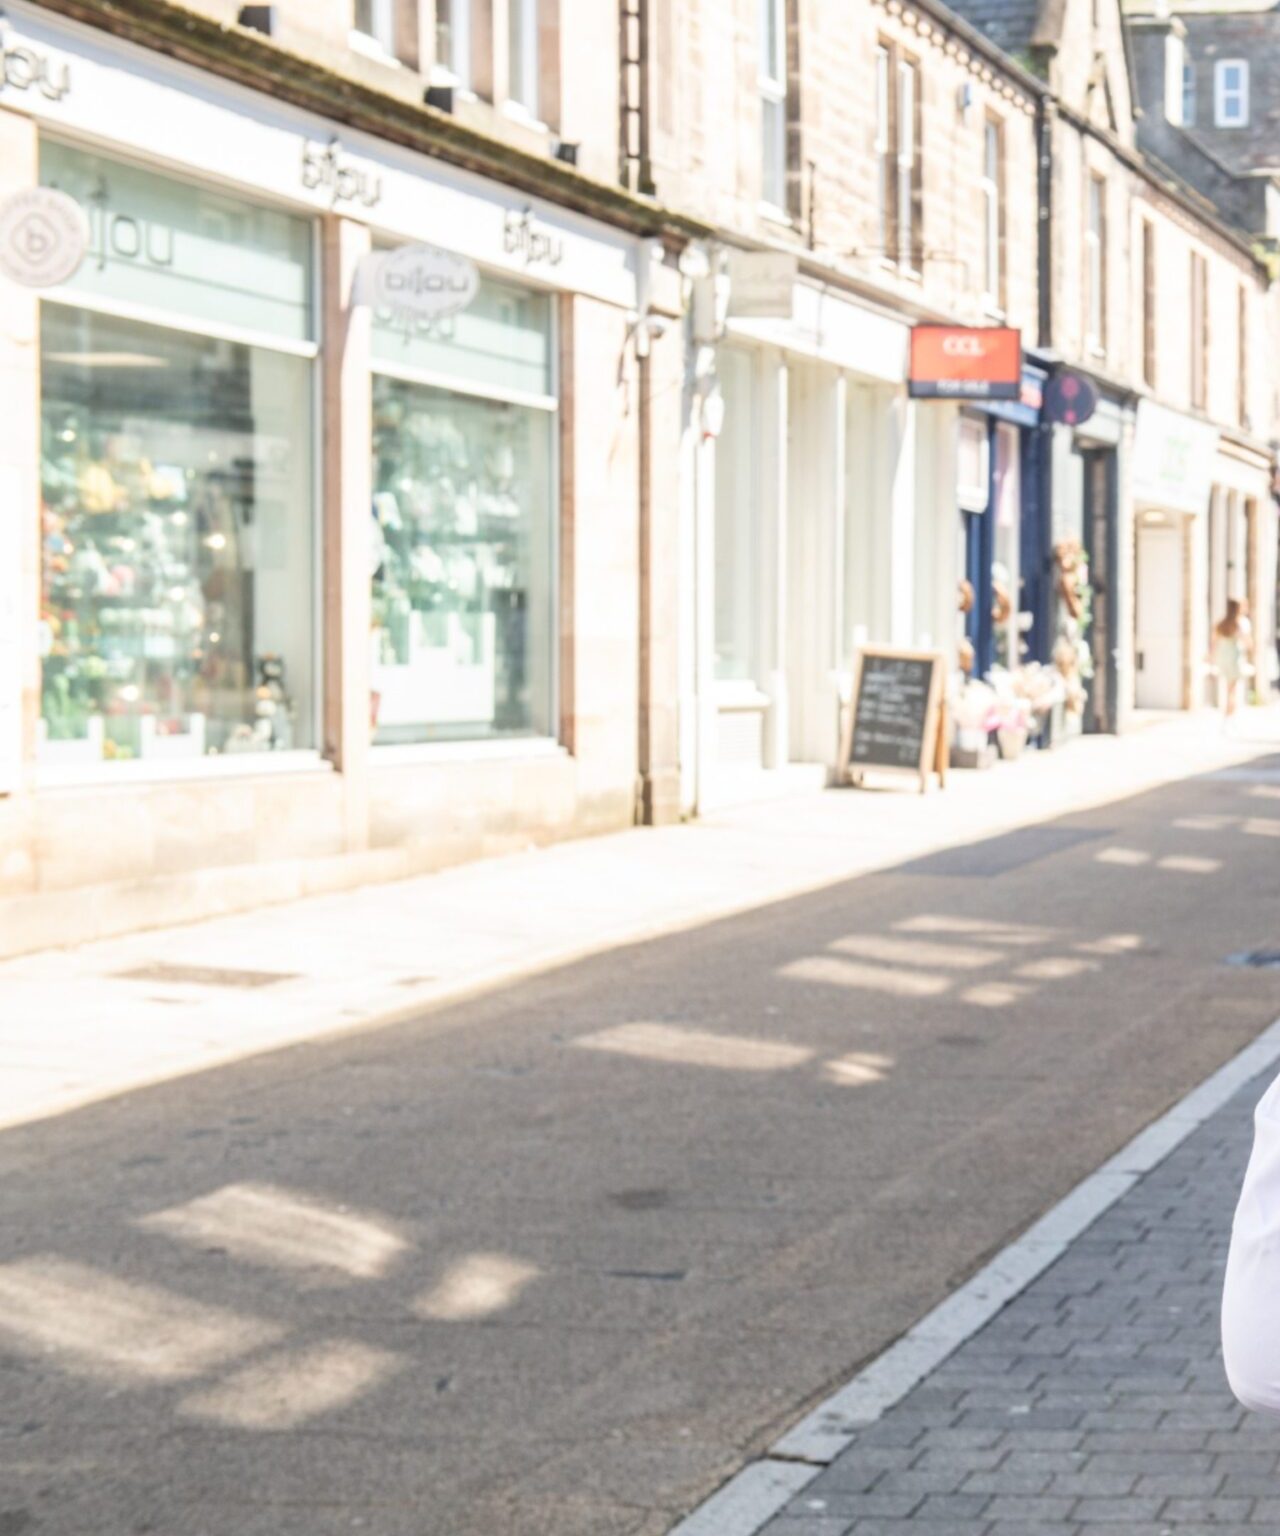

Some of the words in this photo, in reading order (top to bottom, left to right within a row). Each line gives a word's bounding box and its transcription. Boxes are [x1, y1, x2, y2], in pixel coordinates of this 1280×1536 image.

[302, 133, 382, 209] bijou
[503, 204, 563, 267] bijou
[385, 264, 469, 298] bijou
